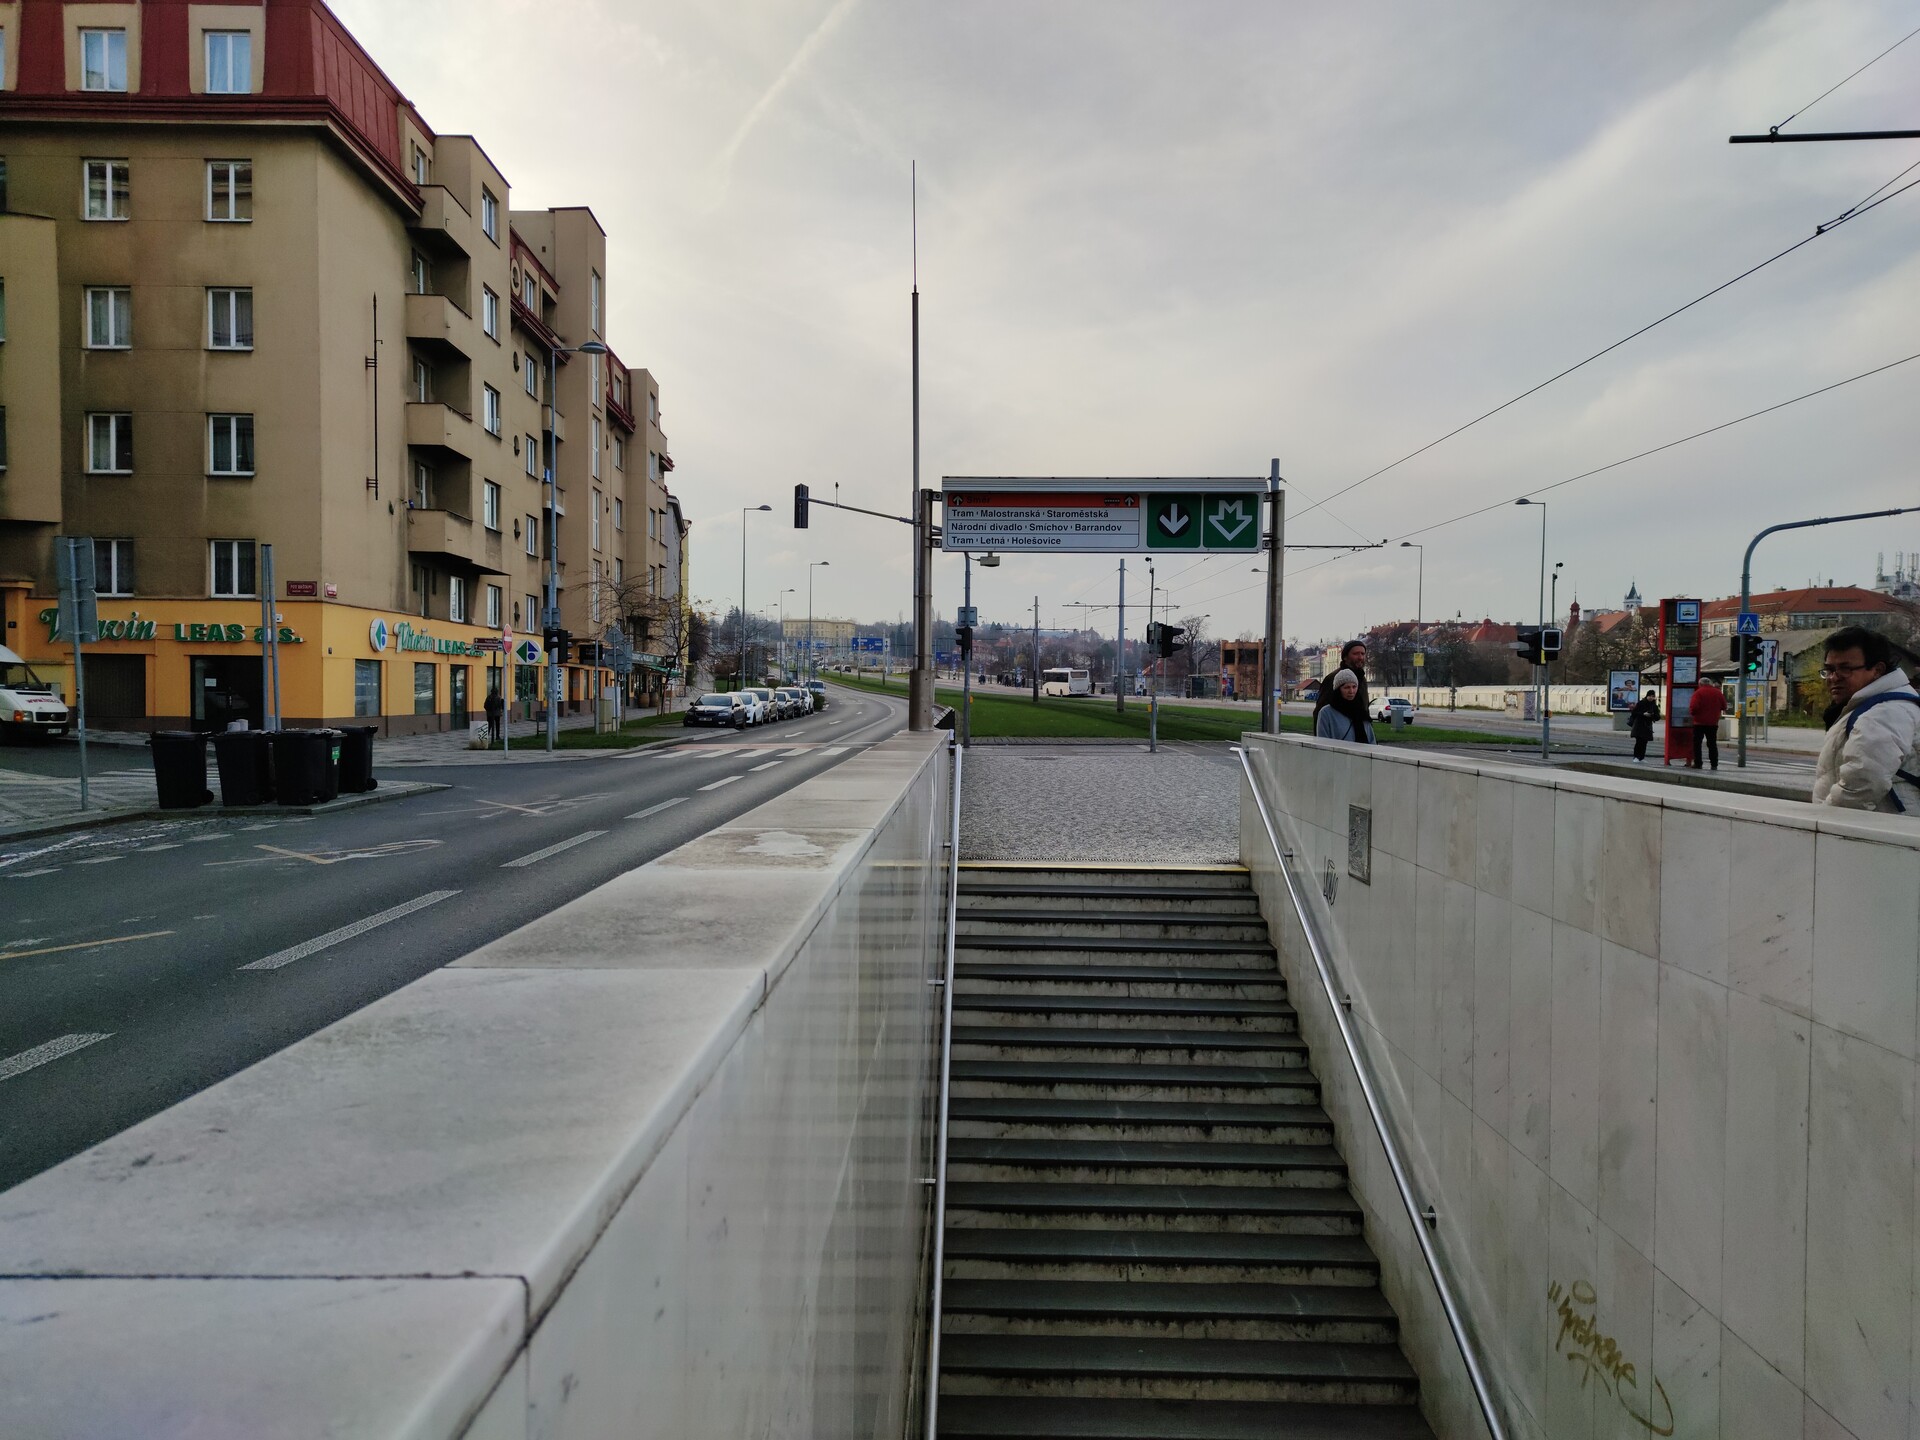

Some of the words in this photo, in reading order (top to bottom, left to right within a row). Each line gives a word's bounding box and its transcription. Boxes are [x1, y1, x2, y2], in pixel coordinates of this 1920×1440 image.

[951, 509, 974, 517] Tram
[980, 509, 1040, 518] Malostranská
[1046, 509, 1109, 518] Staroměstská
[951, 522, 987, 531] Národní
[989, 523, 1023, 531] divadlo
[1029, 522, 1069, 531] Smíchov
[1074, 523, 1122, 532] Barrandov
[951, 536, 974, 544] Tram
[980, 536, 1005, 545] Letná
[1011, 536, 1061, 545] Holešovice
[174, 623, 246, 642] LEAS
[434, 637, 467, 656] LEAS
